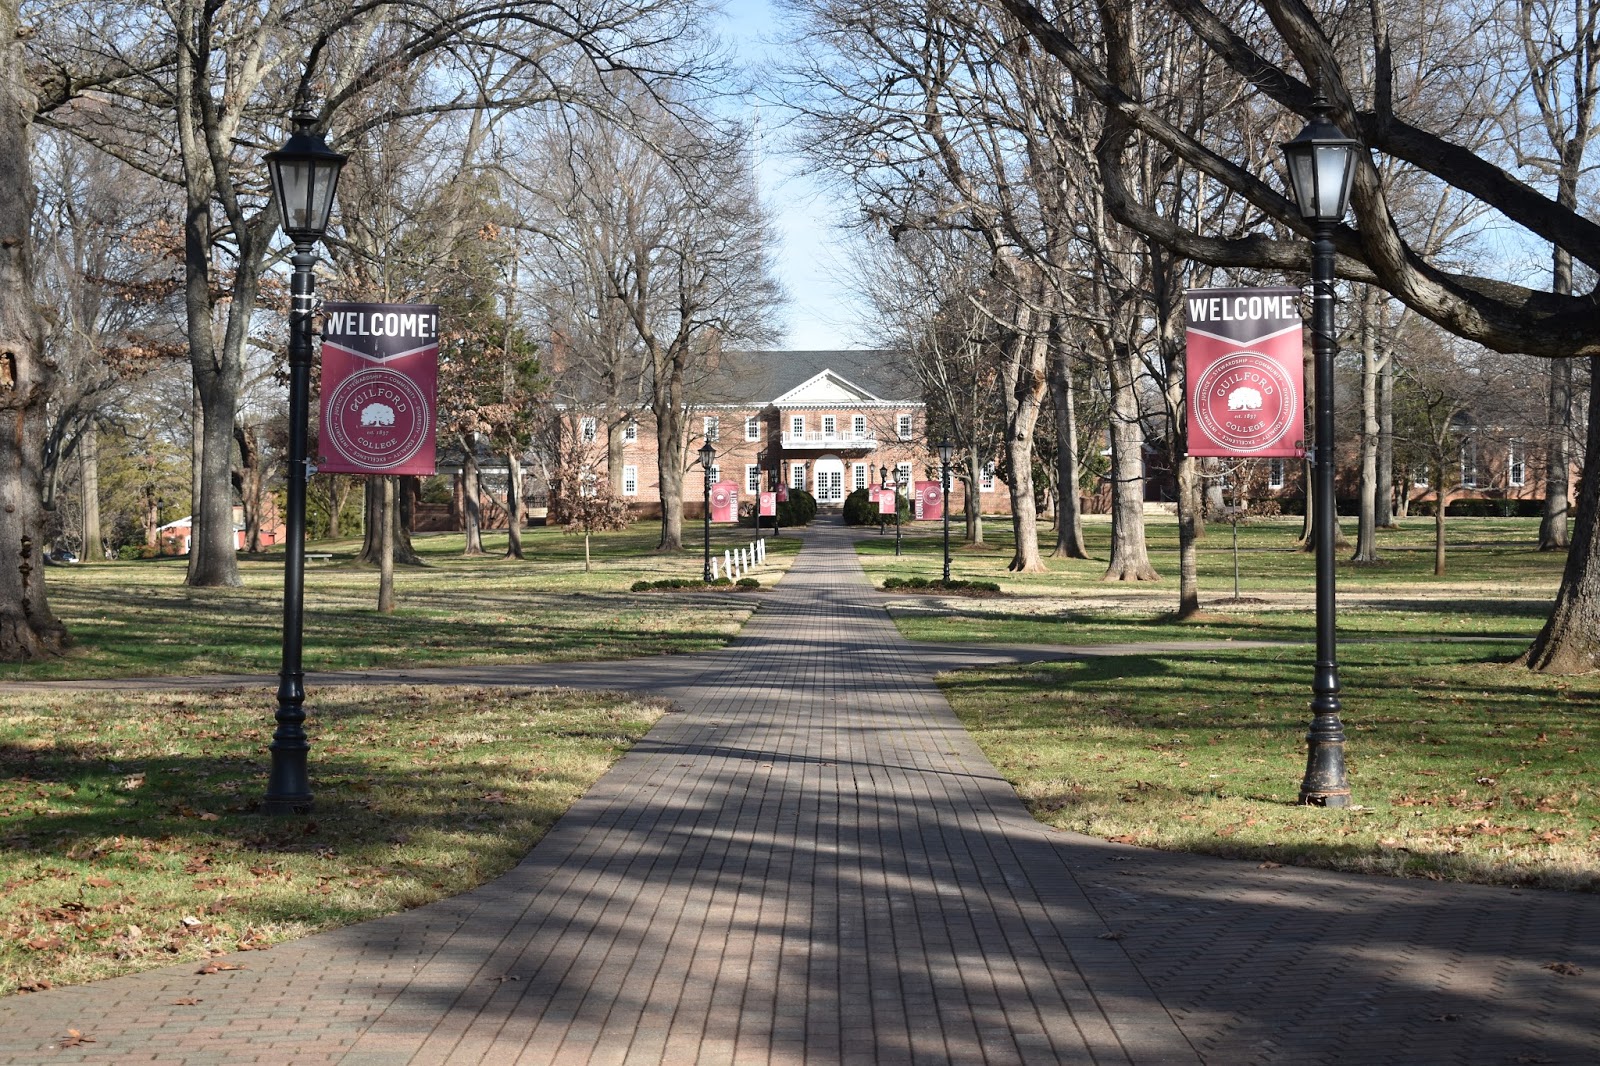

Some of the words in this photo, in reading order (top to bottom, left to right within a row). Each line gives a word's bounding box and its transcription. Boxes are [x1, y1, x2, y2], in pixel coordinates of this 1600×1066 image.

[1189, 295, 1299, 322] WELCOME!
[327, 311, 436, 338] WELCOME!
[1213, 358, 1248, 376] STEWARDSHIP
[1254, 360, 1283, 381] COMMUNITY
[347, 374, 383, 390] STEWARDSHIP
[389, 377, 416, 399] COMMUNITY
[1201, 381, 1211, 402] JUSTICE
[1216, 372, 1274, 397] GUILFORD
[350, 388, 407, 413] GUILFORD
[1225, 420, 1266, 433] COLLEGE
[357, 437, 398, 450] COLLEGE
[730, 490, 738, 520] DIVERSITY
